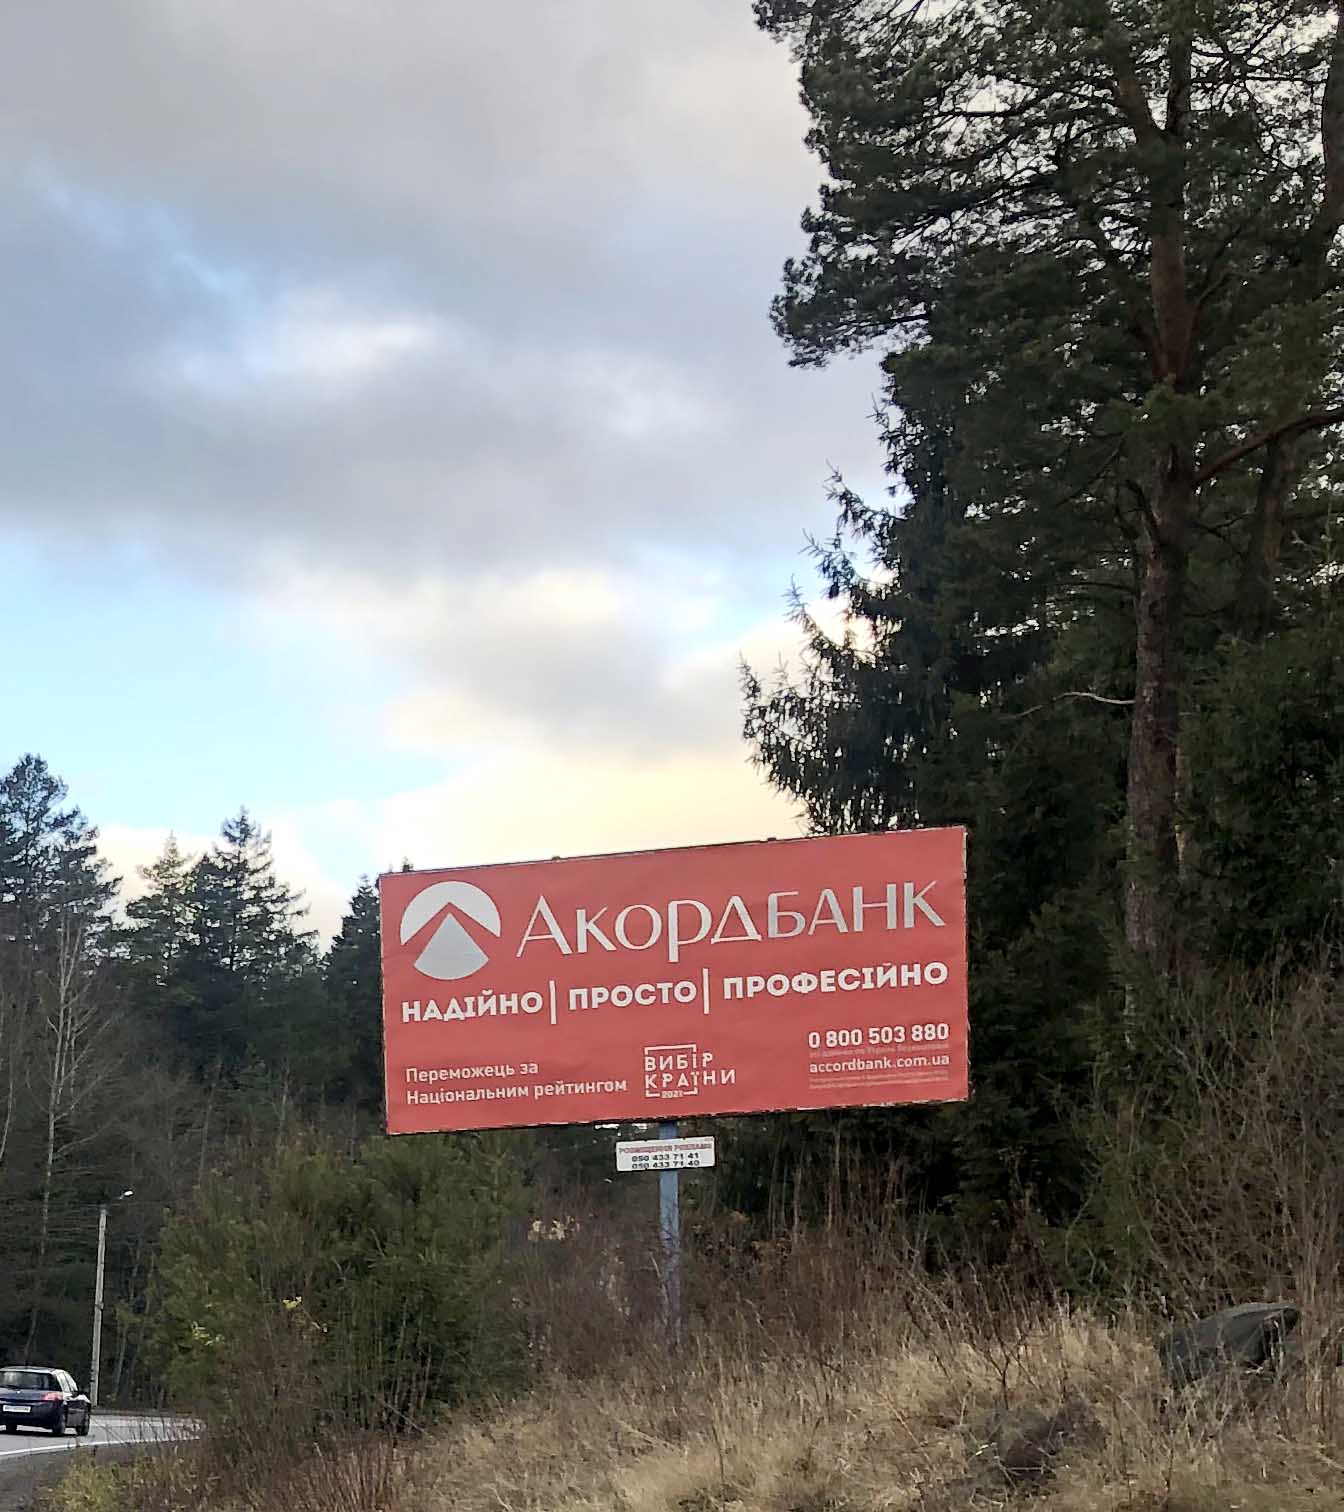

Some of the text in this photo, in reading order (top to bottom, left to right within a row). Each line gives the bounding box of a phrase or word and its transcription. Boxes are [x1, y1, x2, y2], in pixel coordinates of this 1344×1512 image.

[401, 961, 949, 1023] НАДІЙНО ПРОСТО ПРОФЕСІЙНО
[808, 1022, 950, 1049] 0 800 503 880
[405, 1061, 539, 1085] Переможець за
[809, 1054, 950, 1074] accordbank.com.ua
[406, 1078, 628, 1105] Національним рейтингом
[644, 1069, 736, 1089] КРАЇНИ
